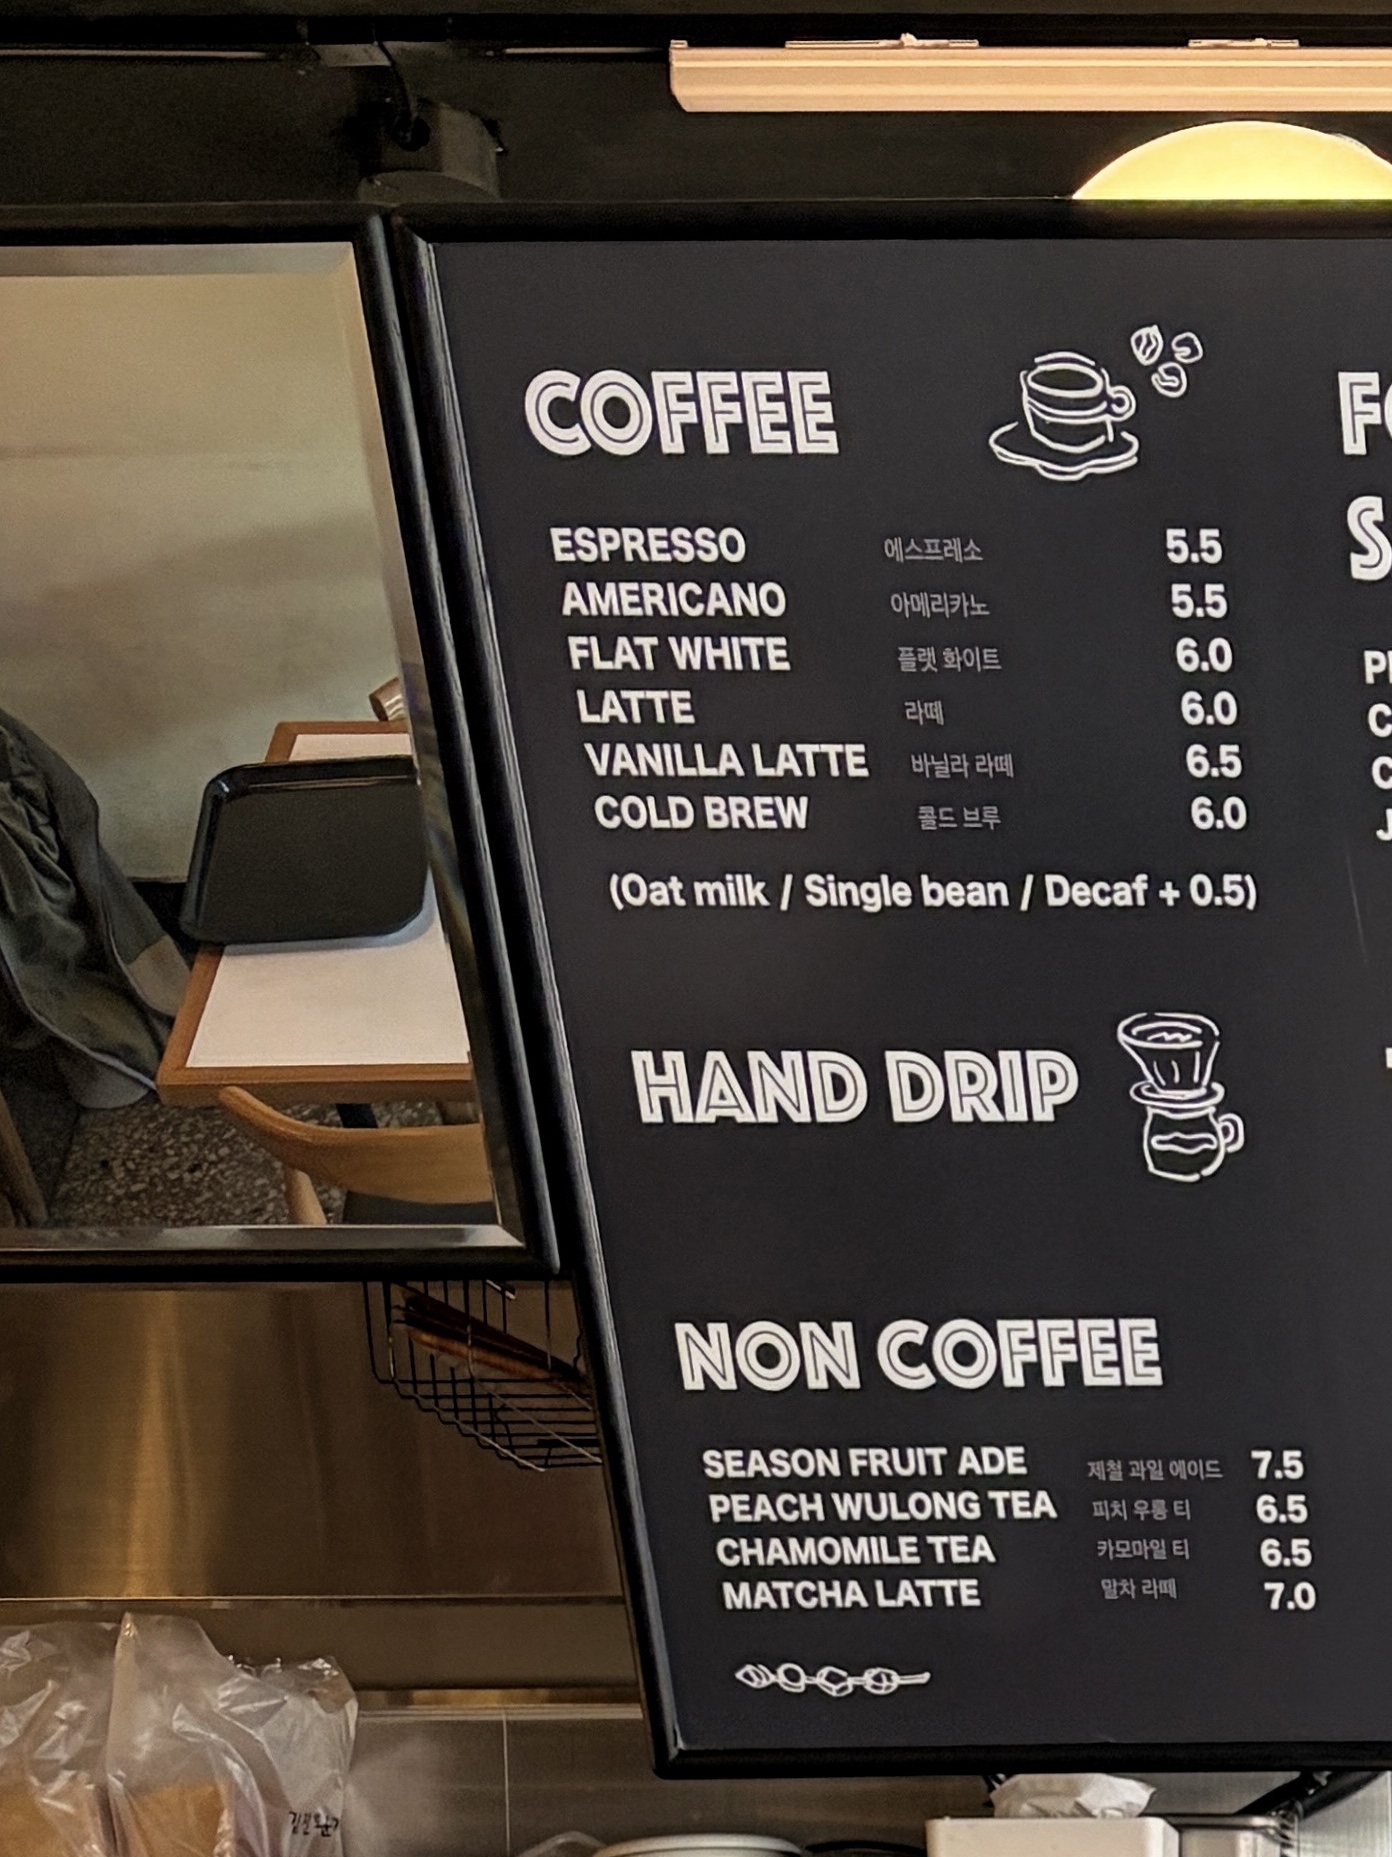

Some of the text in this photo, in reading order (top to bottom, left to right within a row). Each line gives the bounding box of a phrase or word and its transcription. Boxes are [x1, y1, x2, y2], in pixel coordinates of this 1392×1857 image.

[525, 370, 839, 455] COFFEE
[550, 527, 746, 562] ESPRESSO
[884, 536, 984, 563] 에스프레소
[1166, 528, 1223, 564] 5.5
[562, 582, 786, 617] AMERICANO
[890, 591, 990, 619] 아메리카노
[1171, 583, 1228, 619] 5.5
[567, 635, 791, 671] FLAT WHITE
[897, 646, 1002, 673] 플랫 화이트
[1175, 637, 1233, 673] 6.0
[576, 689, 696, 724] LATTE
[904, 699, 945, 726] 라떼
[1181, 690, 1238, 726] 6.0
[583, 742, 869, 777] VANILLA LATTE
[910, 752, 1014, 779] 바닐라 라떼
[1186, 743, 1242, 778] 6.5
[594, 795, 808, 829] COLD BREW
[917, 805, 1002, 831] 콜드 브루
[1191, 796, 1247, 830] 6.0
[609, 872, 687, 911] (Oat
[693, 873, 770, 906] milk
[804, 873, 912, 913] Single
[920, 874, 1010, 907] bean
[1044, 873, 1149, 907] Decaf
[1189, 873, 1257, 911] 0.5)
[631, 1050, 1078, 1123] HAND DRIP
[675, 1319, 1162, 1391] NON COFFEE
[702, 1446, 1027, 1479] SEASON FRUIT ADE
[1087, 1458, 1224, 1482] 제철 과일 에이드
[1251, 1450, 1304, 1480] 7.5
[709, 1490, 1058, 1523] PEACH WULONG TEA
[1092, 1498, 1191, 1521] 피치 우롱 티
[1256, 1494, 1308, 1524] 6.5
[716, 1534, 996, 1566] CHAMOMILE TEA
[1097, 1538, 1190, 1561] 카모마일 티
[1260, 1538, 1312, 1567] 6.5
[722, 1578, 981, 1610] MATCHA LATTE
[1100, 1577, 1177, 1600] 말차 라떼
[1263, 1581, 1316, 1611] 7.0
